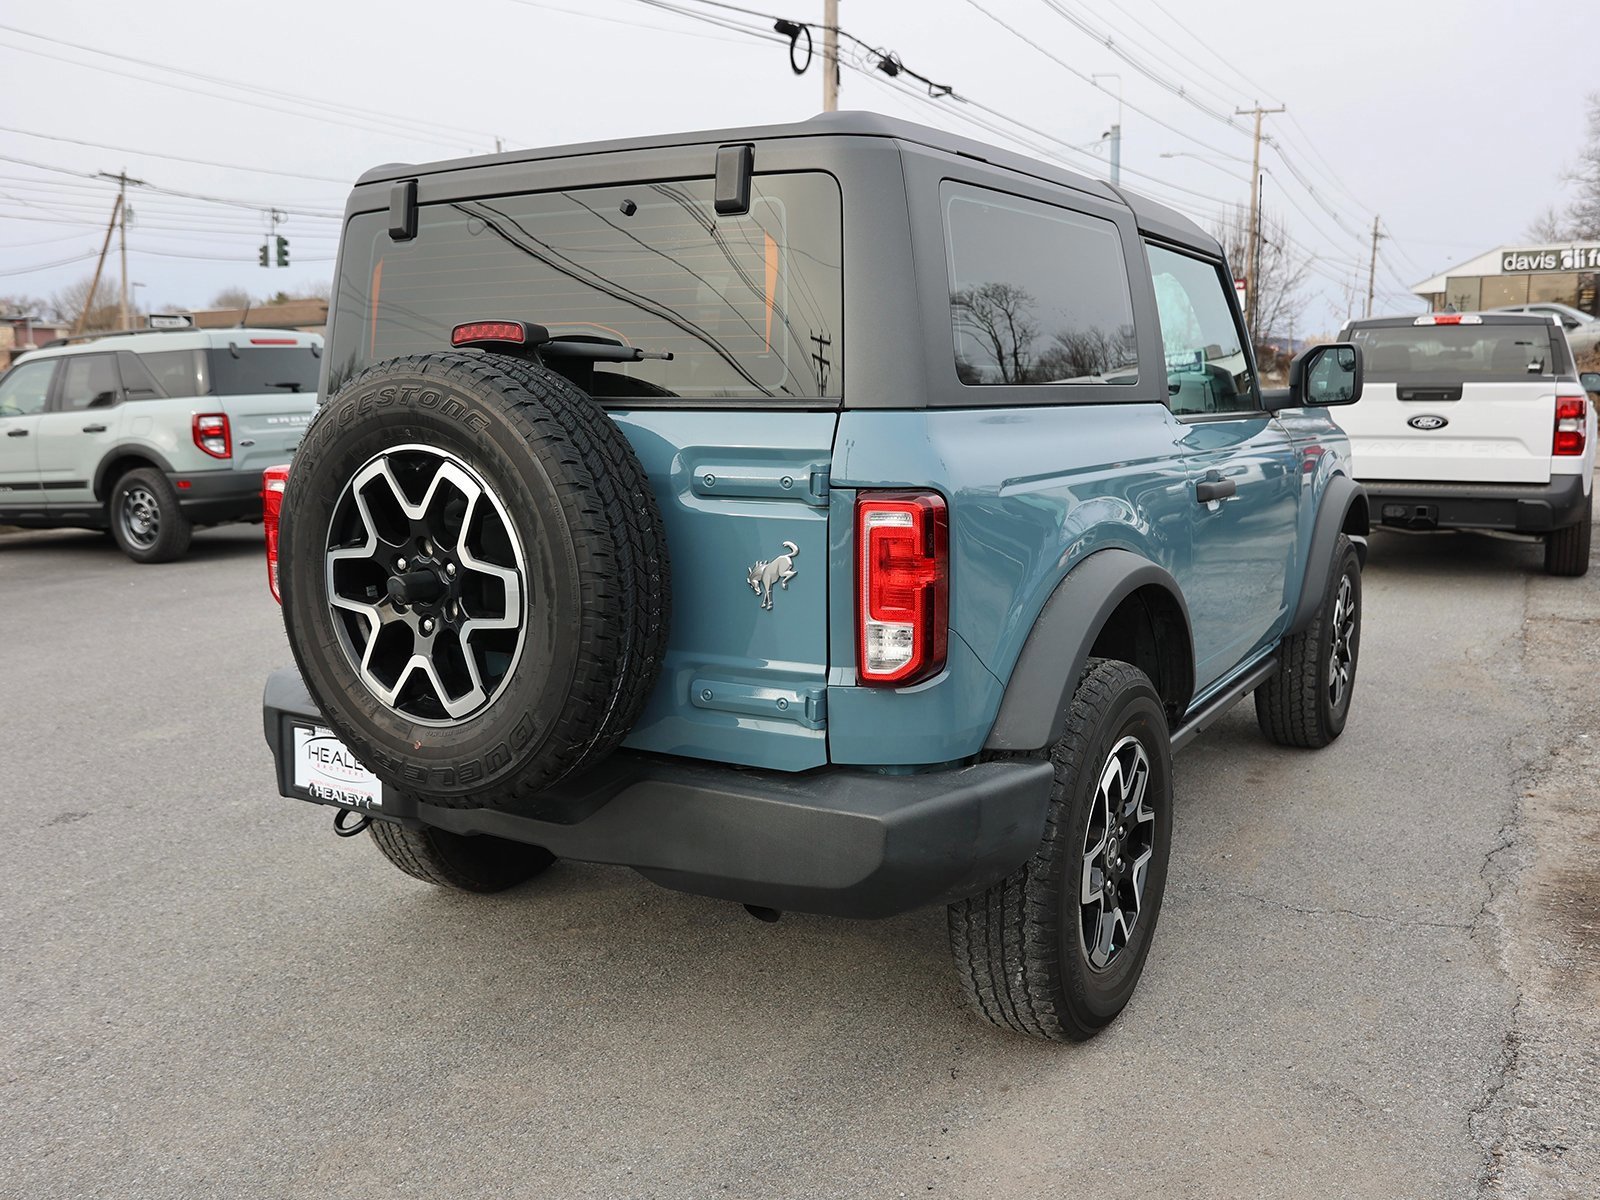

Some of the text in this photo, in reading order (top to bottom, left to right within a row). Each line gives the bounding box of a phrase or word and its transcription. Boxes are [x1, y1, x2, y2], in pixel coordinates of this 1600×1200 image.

[1503, 251, 1556, 270] davis
[288, 384, 492, 512] BRIDGESTONE
[373, 711, 536, 786] DUELER
[315, 785, 363, 807] HEALEY
